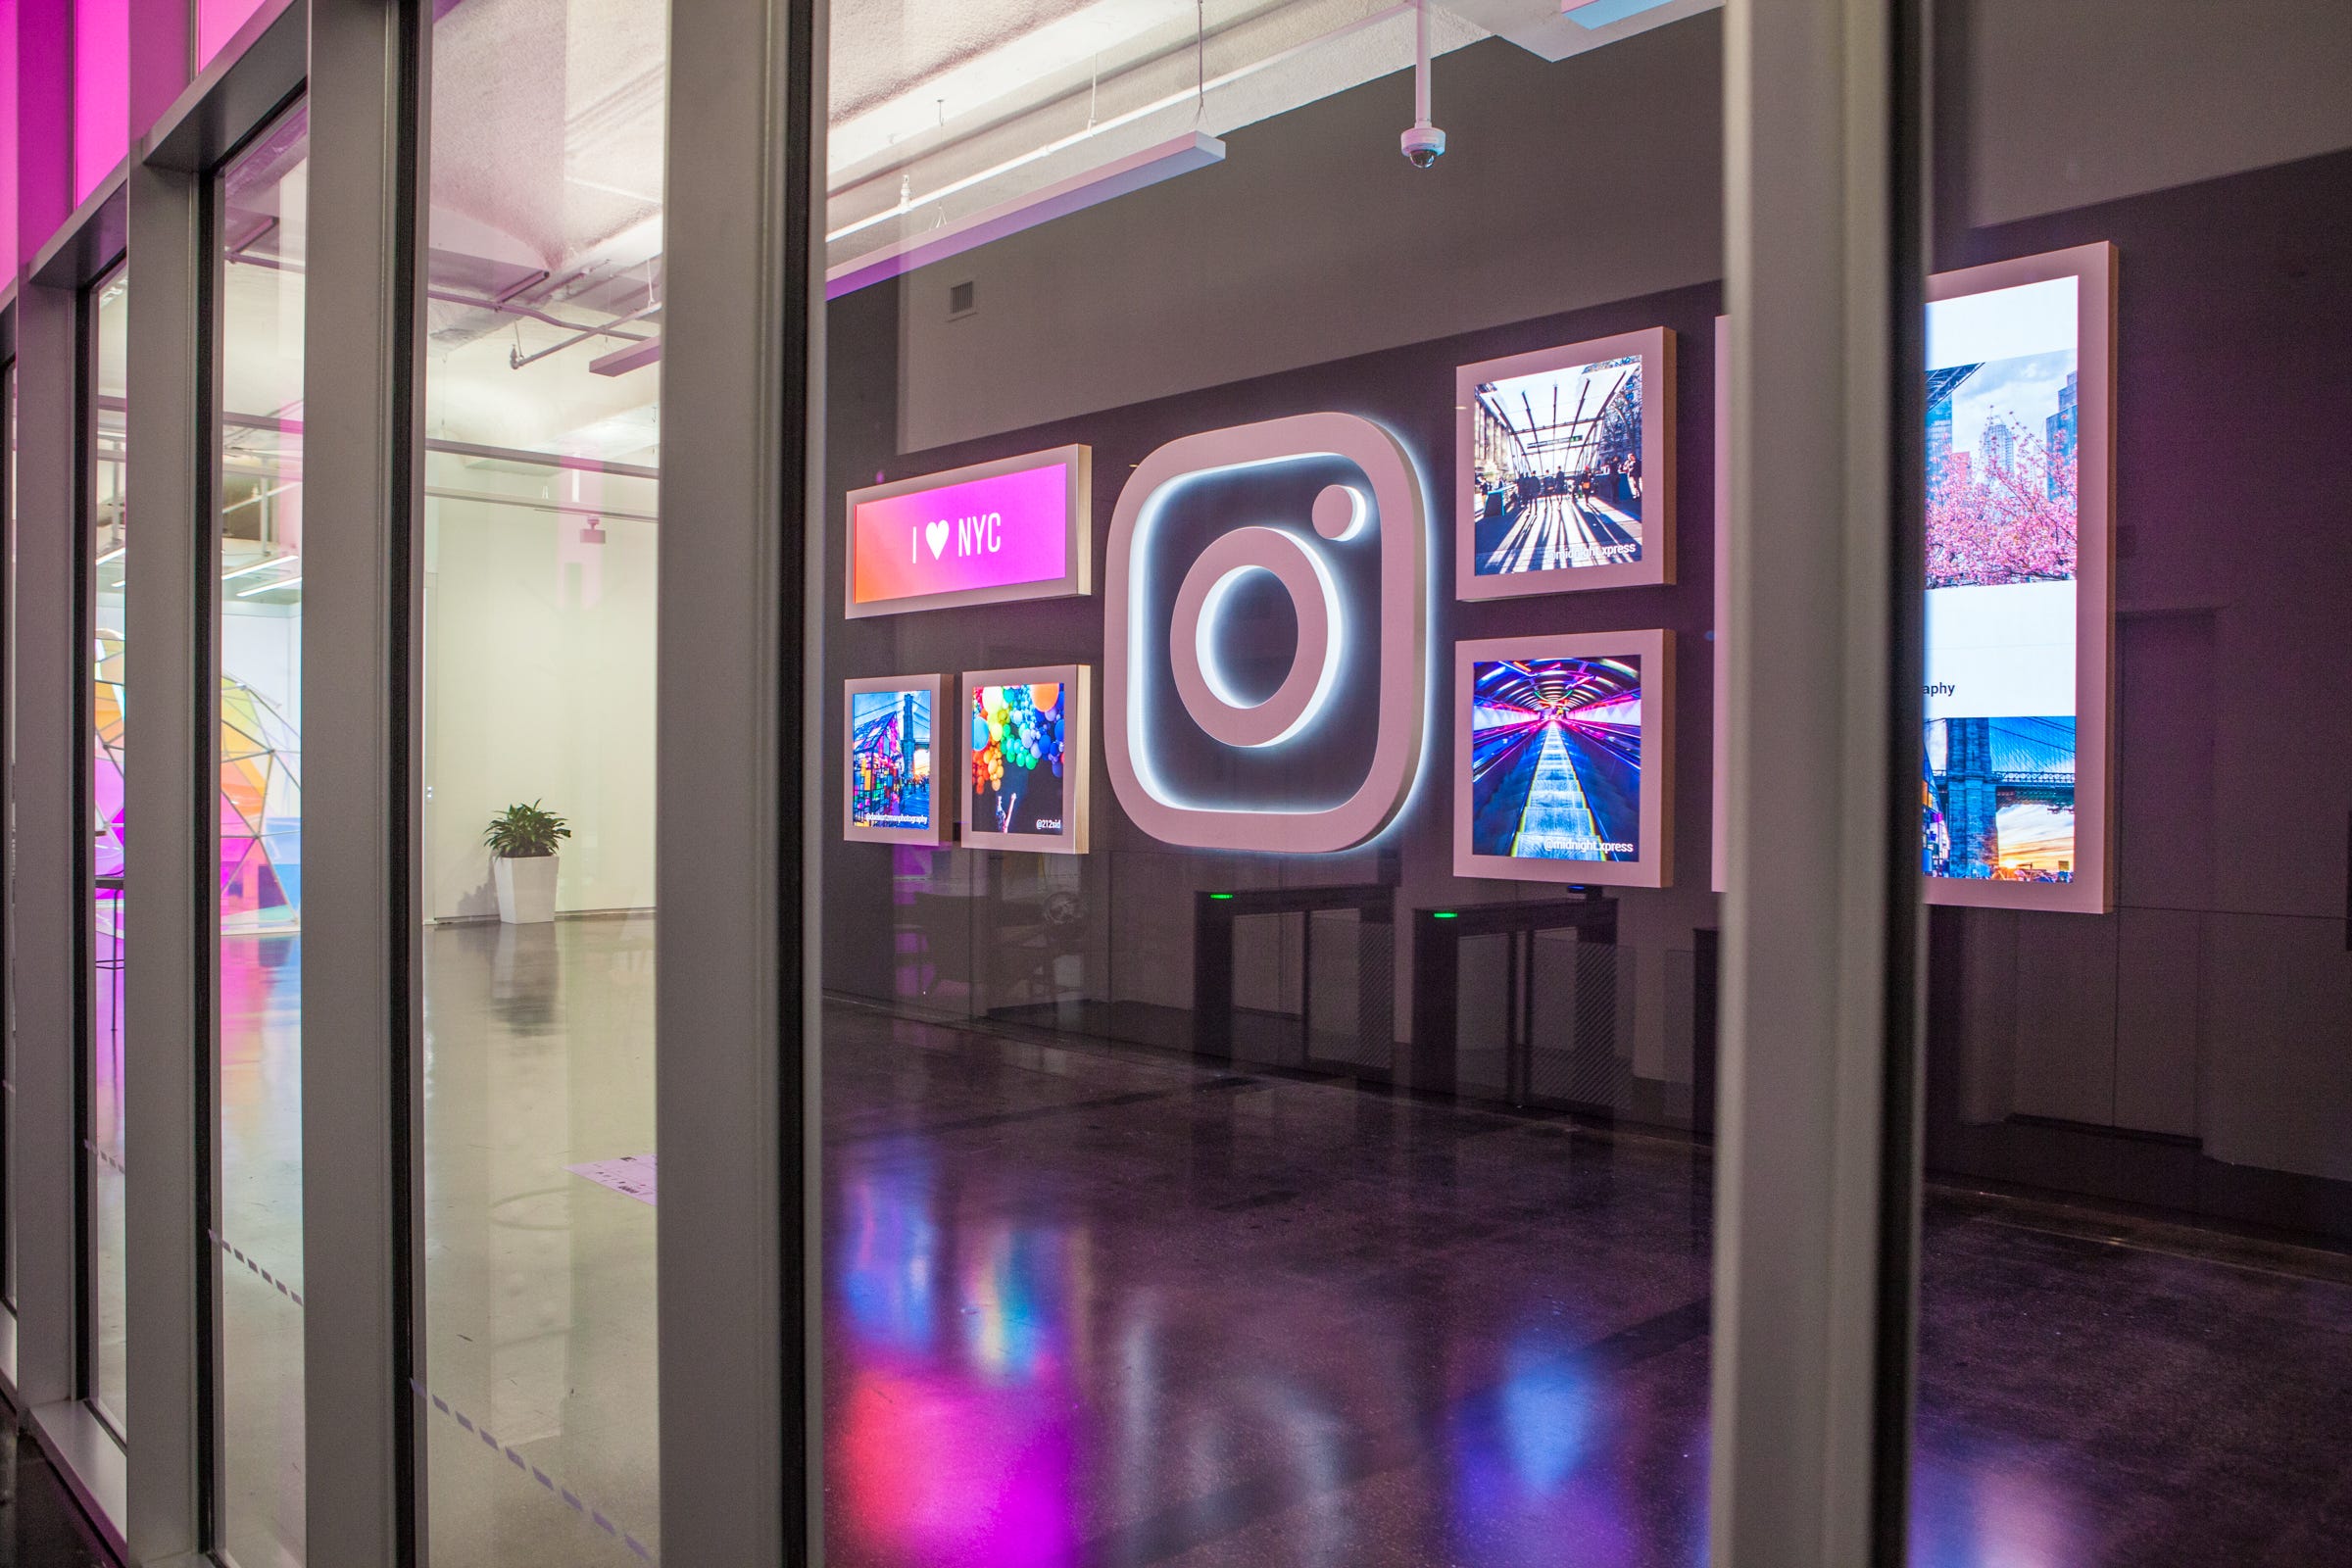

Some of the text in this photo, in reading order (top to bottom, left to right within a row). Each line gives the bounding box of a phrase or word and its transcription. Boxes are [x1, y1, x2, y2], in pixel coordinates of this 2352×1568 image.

[911, 512, 1002, 564] I NYC
[1036, 818, 1061, 830] @212sid
